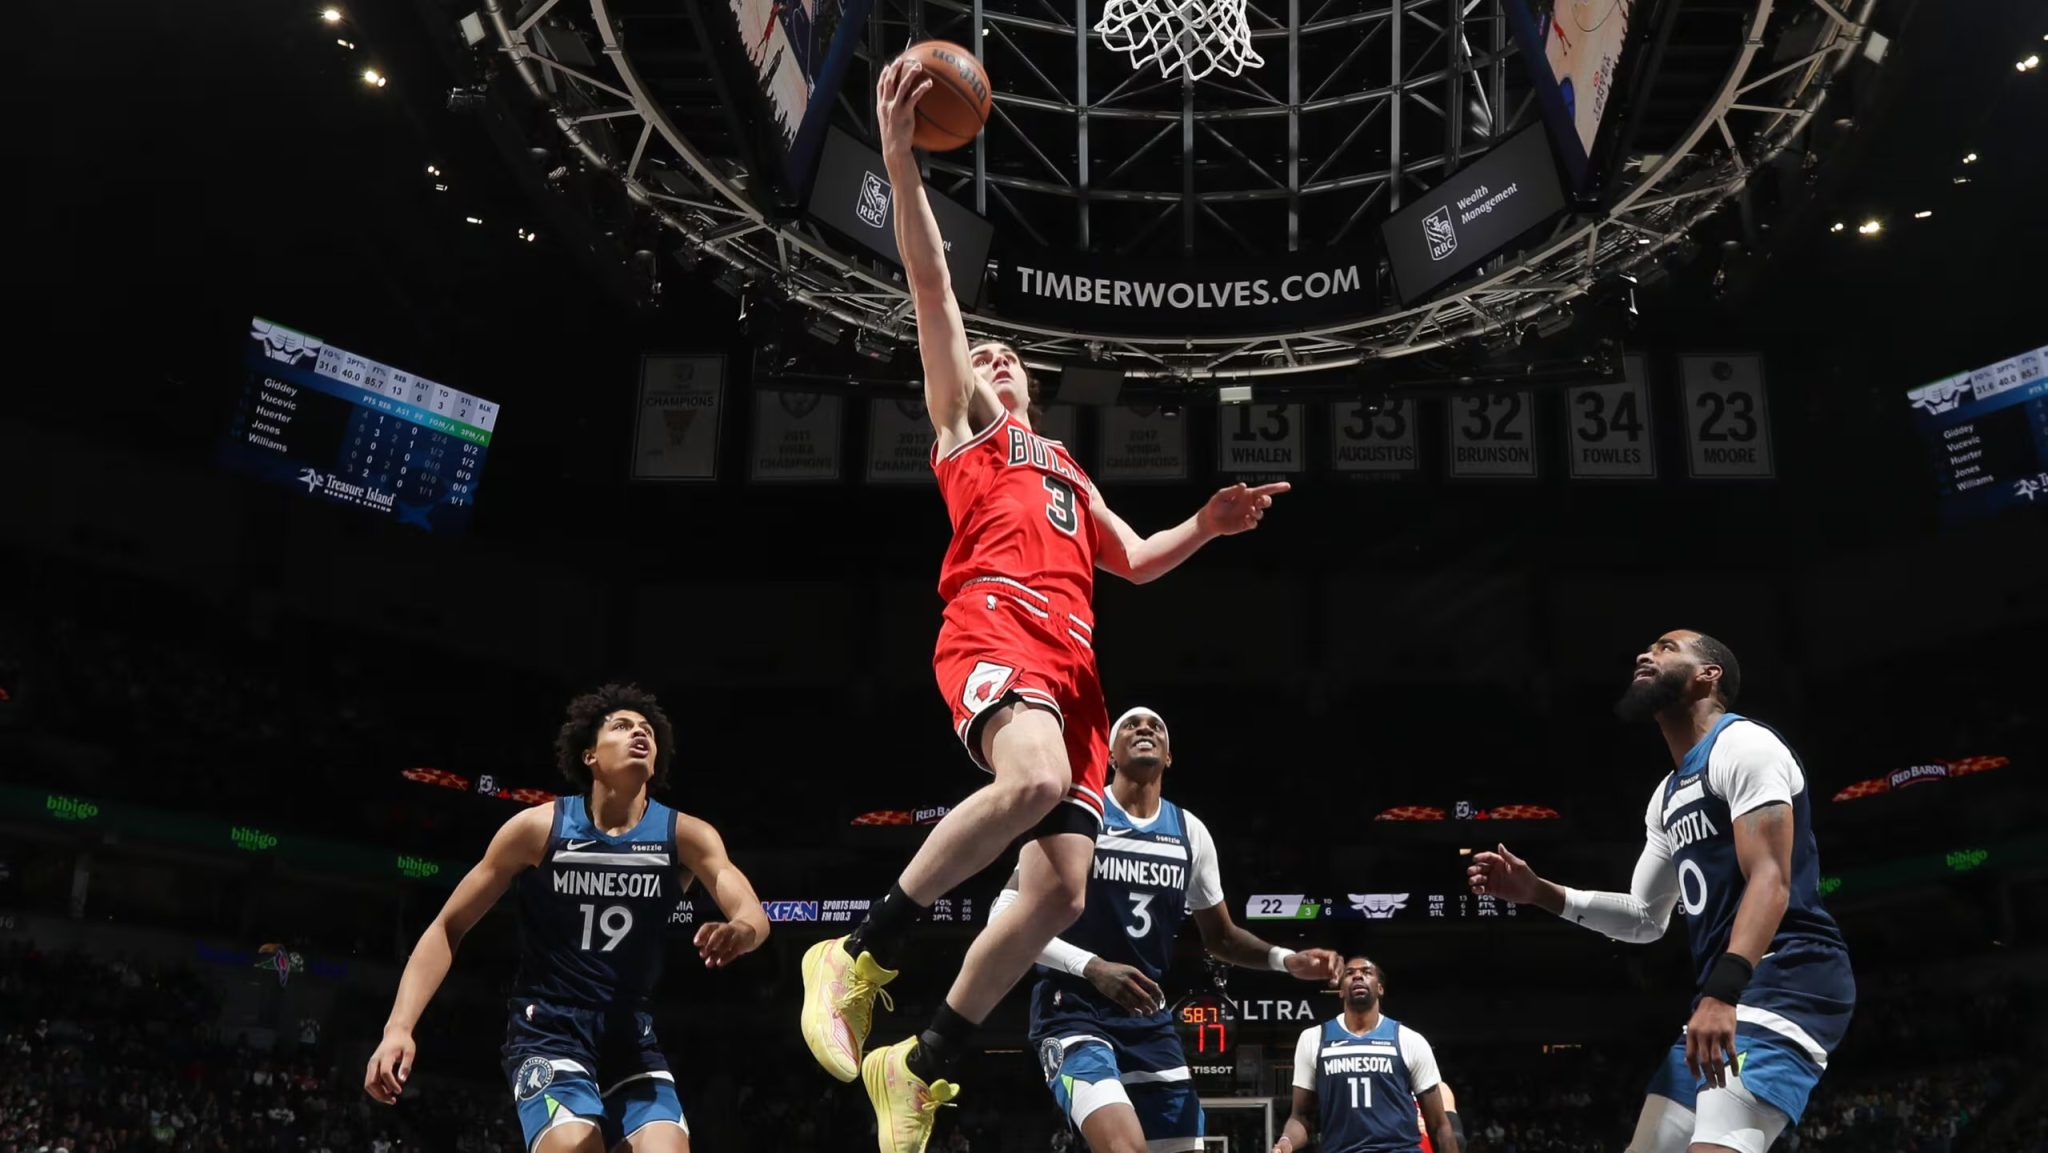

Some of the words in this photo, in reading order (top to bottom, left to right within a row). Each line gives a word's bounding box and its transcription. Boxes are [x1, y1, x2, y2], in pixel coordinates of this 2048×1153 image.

[1457, 185, 1488, 210] Wealth
[1461, 182, 1518, 224] Management
[860, 205, 882, 224] RBC
[1434, 238, 1454, 257] RBC
[1017, 265, 1360, 308] TIMBERWOLVES.COM
[318, 361, 338, 374] 31.6
[342, 368, 361, 381] 40.0
[364, 377, 383, 389] 85.7
[392, 386, 402, 396] 13
[1976, 382, 1995, 394] 31.6
[1999, 374, 2016, 386] 40.0
[2021, 367, 2039, 379] 85.7
[415, 381, 429, 391] AST
[439, 389, 449, 398] TO
[479, 404, 492, 413] BLK
[645, 395, 714, 408] CHAMPIONS
[264, 377, 298, 397] Giddey
[464, 443, 478, 455] 0/2
[396, 407, 410, 417] AST
[1232, 404, 1291, 441] 13
[1344, 401, 1405, 440] 33
[1461, 393, 1523, 440] 32
[1575, 392, 1643, 442] 34
[1696, 392, 1757, 442] 23
[260, 391, 297, 411] Vucevic
[462, 457, 475, 468] 1/2
[1943, 423, 1975, 439] Giddey
[256, 405, 292, 424] Huerter
[456, 469, 471, 481] 0/0
[1338, 446, 1414, 462] AUGUSTUS
[1946, 435, 1981, 452] Vucevic
[251, 419, 280, 435] Jones
[453, 482, 468, 494] 0/0
[1232, 448, 1291, 463] WHALEN
[1457, 447, 1529, 462] BRUNSON
[1583, 448, 1641, 463] FOWLES
[1704, 448, 1756, 463] MOORE
[1950, 449, 1983, 466] Huerter
[248, 432, 288, 453] Williams
[451, 496, 464, 506] 1/1
[1954, 464, 1981, 479] Jones
[326, 473, 364, 498] Treasure
[366, 487, 395, 507] Island
[1956, 474, 1995, 492] Williams
[1042, 474, 1077, 536] 3
[1891, 771, 1911, 787] RED
[1911, 764, 1946, 778] BARON
[46, 795, 99, 820] bibigo
[916, 808, 936, 822] RED
[231, 827, 278, 850] bibigo
[397, 856, 439, 877] bibigo
[1946, 848, 1988, 867] bibigo
[1093, 855, 1185, 890] MINNESOTA
[553, 870, 662, 898] MINNESOTA
[1678, 858, 1708, 915] 0
[762, 901, 818, 921] KFAN
[821, 911, 832, 921] FM
[833, 911, 851, 921] 100.3
[822, 900, 848, 911] SPORTS
[849, 900, 870, 911] RADIO
[1126, 892, 1155, 938] 3
[1261, 899, 1282, 914] 22
[1305, 907, 1311, 916] 3
[1325, 907, 1331, 916] 6
[1430, 909, 1444, 917] STL
[580, 904, 633, 952] 19
[672, 912, 693, 923] POR
[1184, 1007, 1217, 1023] 58.7
[1198, 1024, 1225, 1053] 17
[1193, 1066, 1233, 1074] TISSOT
[1324, 1057, 1393, 1076] MINNESOTA
[1347, 1077, 1372, 1108] 11
